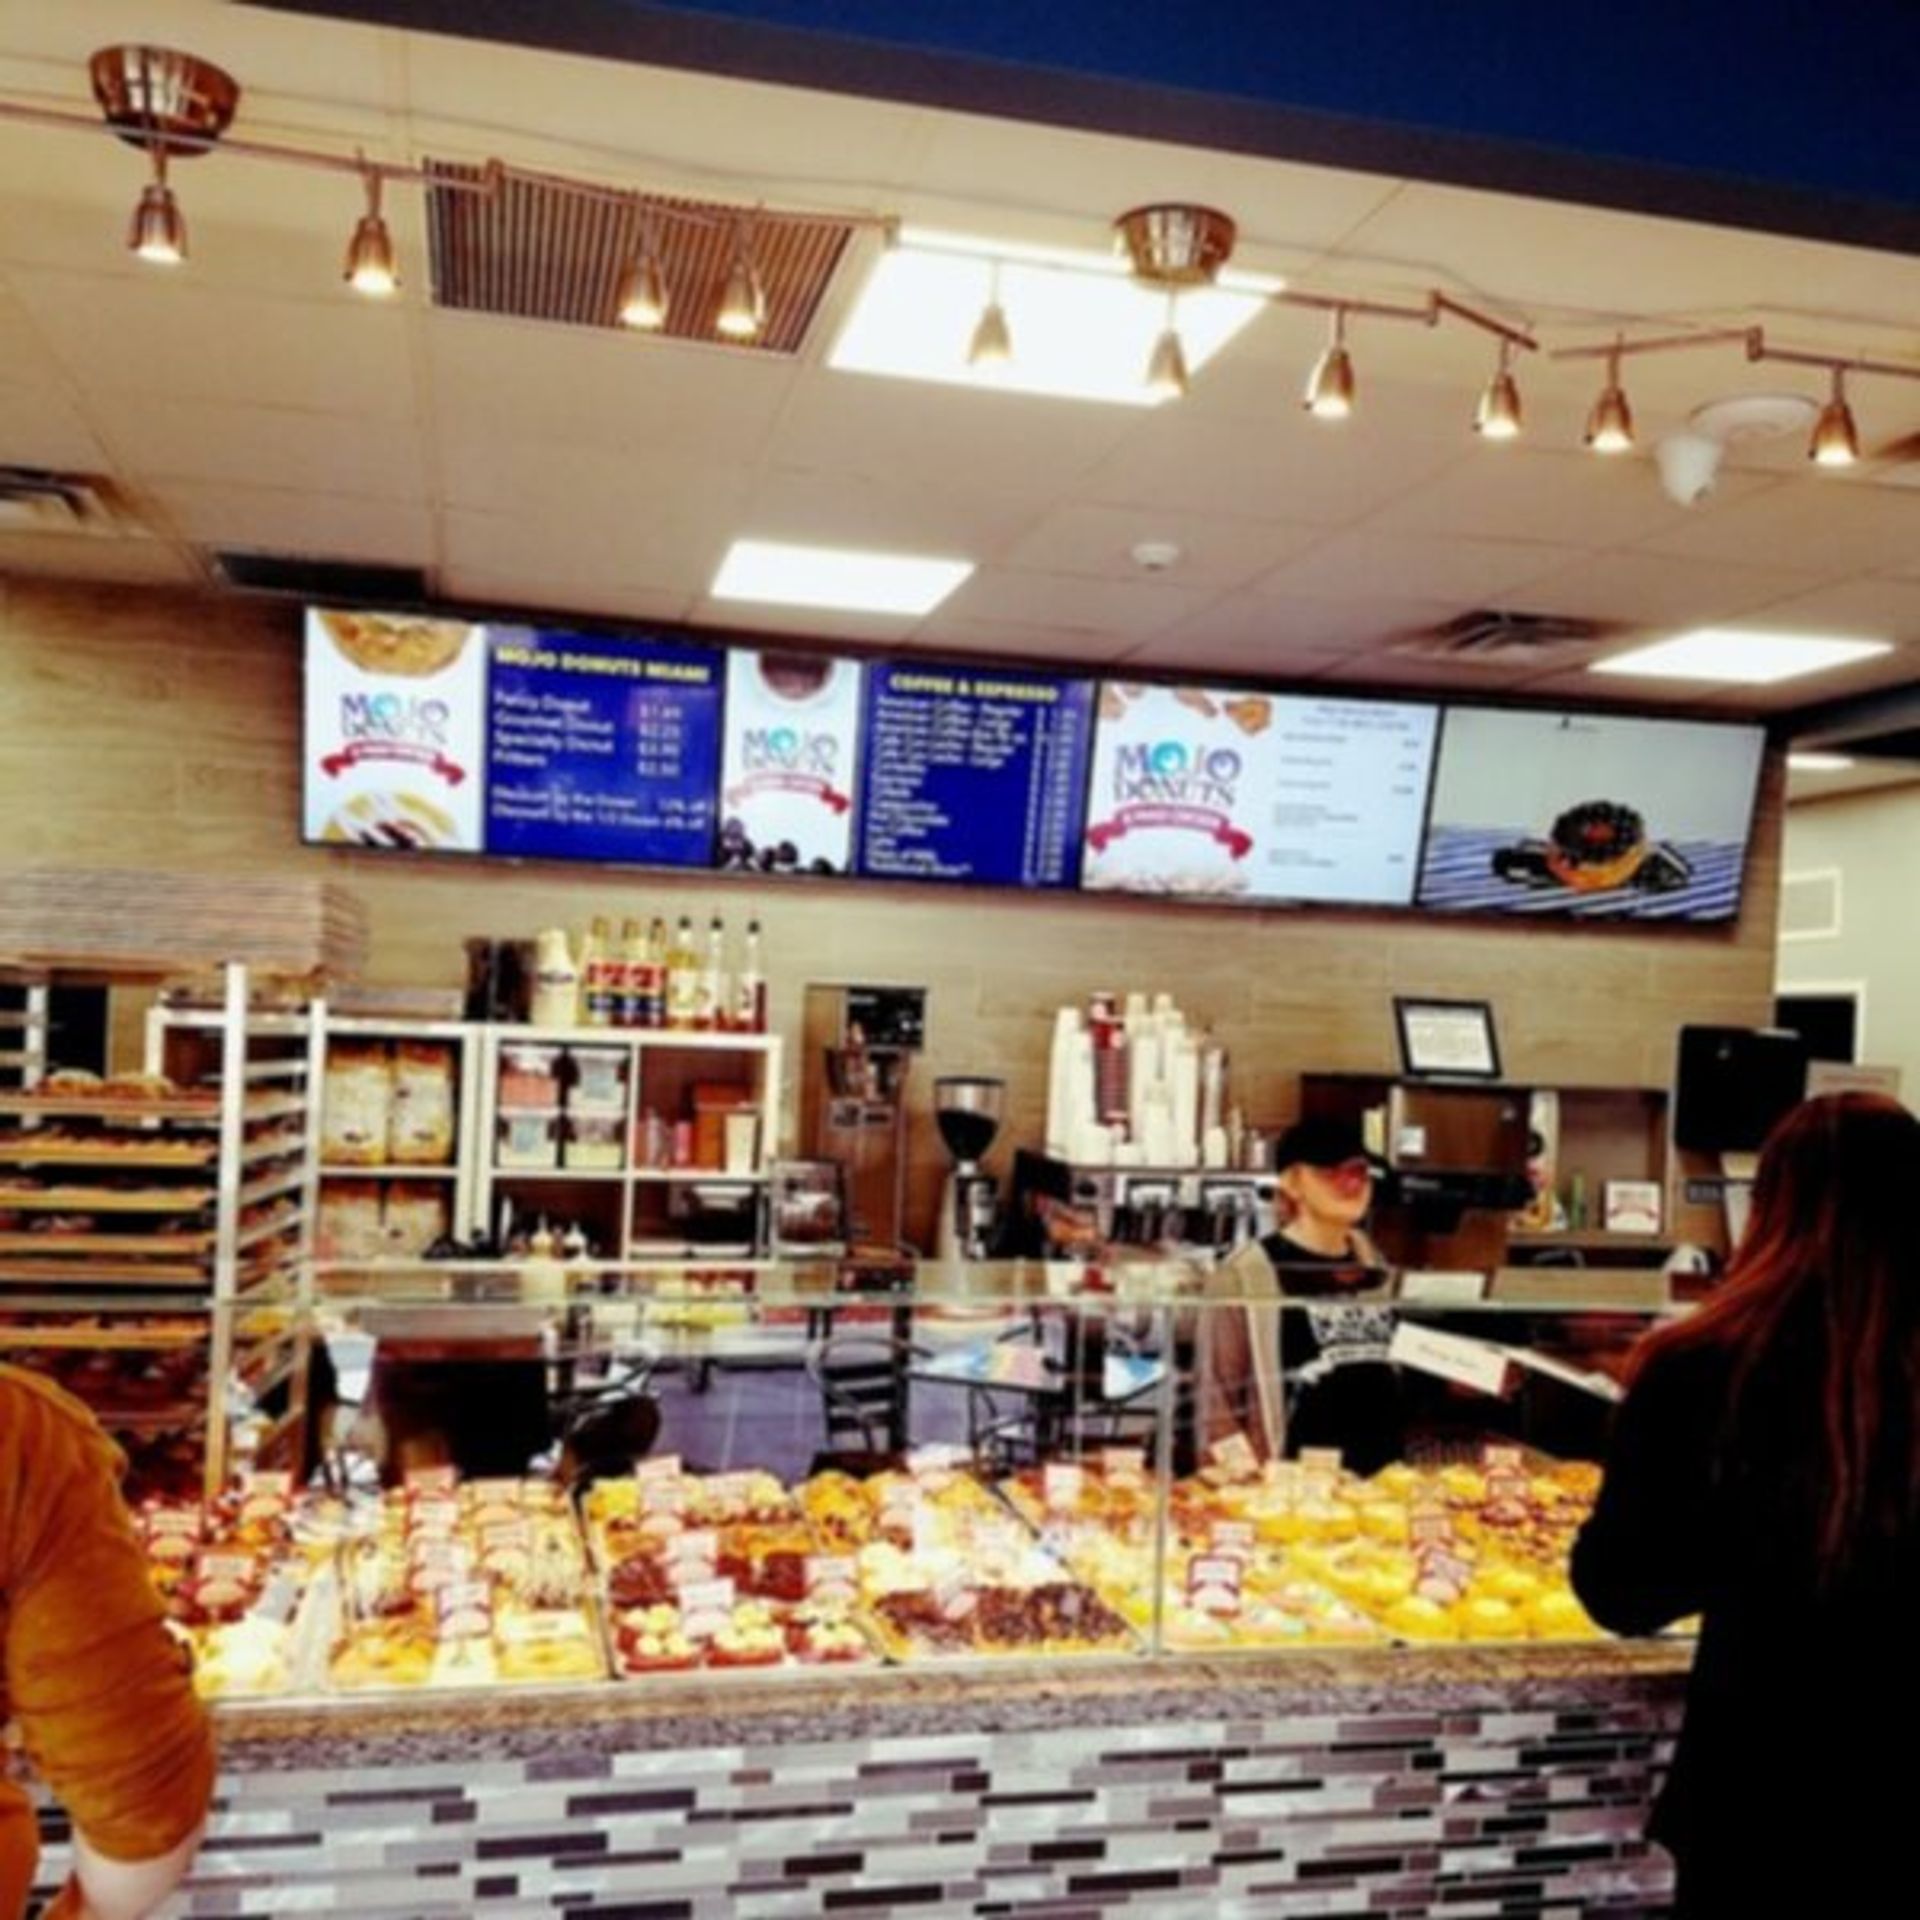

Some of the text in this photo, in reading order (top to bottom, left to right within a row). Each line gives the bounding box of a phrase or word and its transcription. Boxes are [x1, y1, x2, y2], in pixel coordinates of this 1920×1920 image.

[496, 647, 709, 682] MOJO DONUTS MIAMI
[889, 673, 953, 694] COFFEE
[974, 680, 1059, 702] ESPRESSO
[341, 692, 449, 723] MOJO
[743, 727, 839, 762] MOJO
[1116, 740, 1243, 783] MOJO
